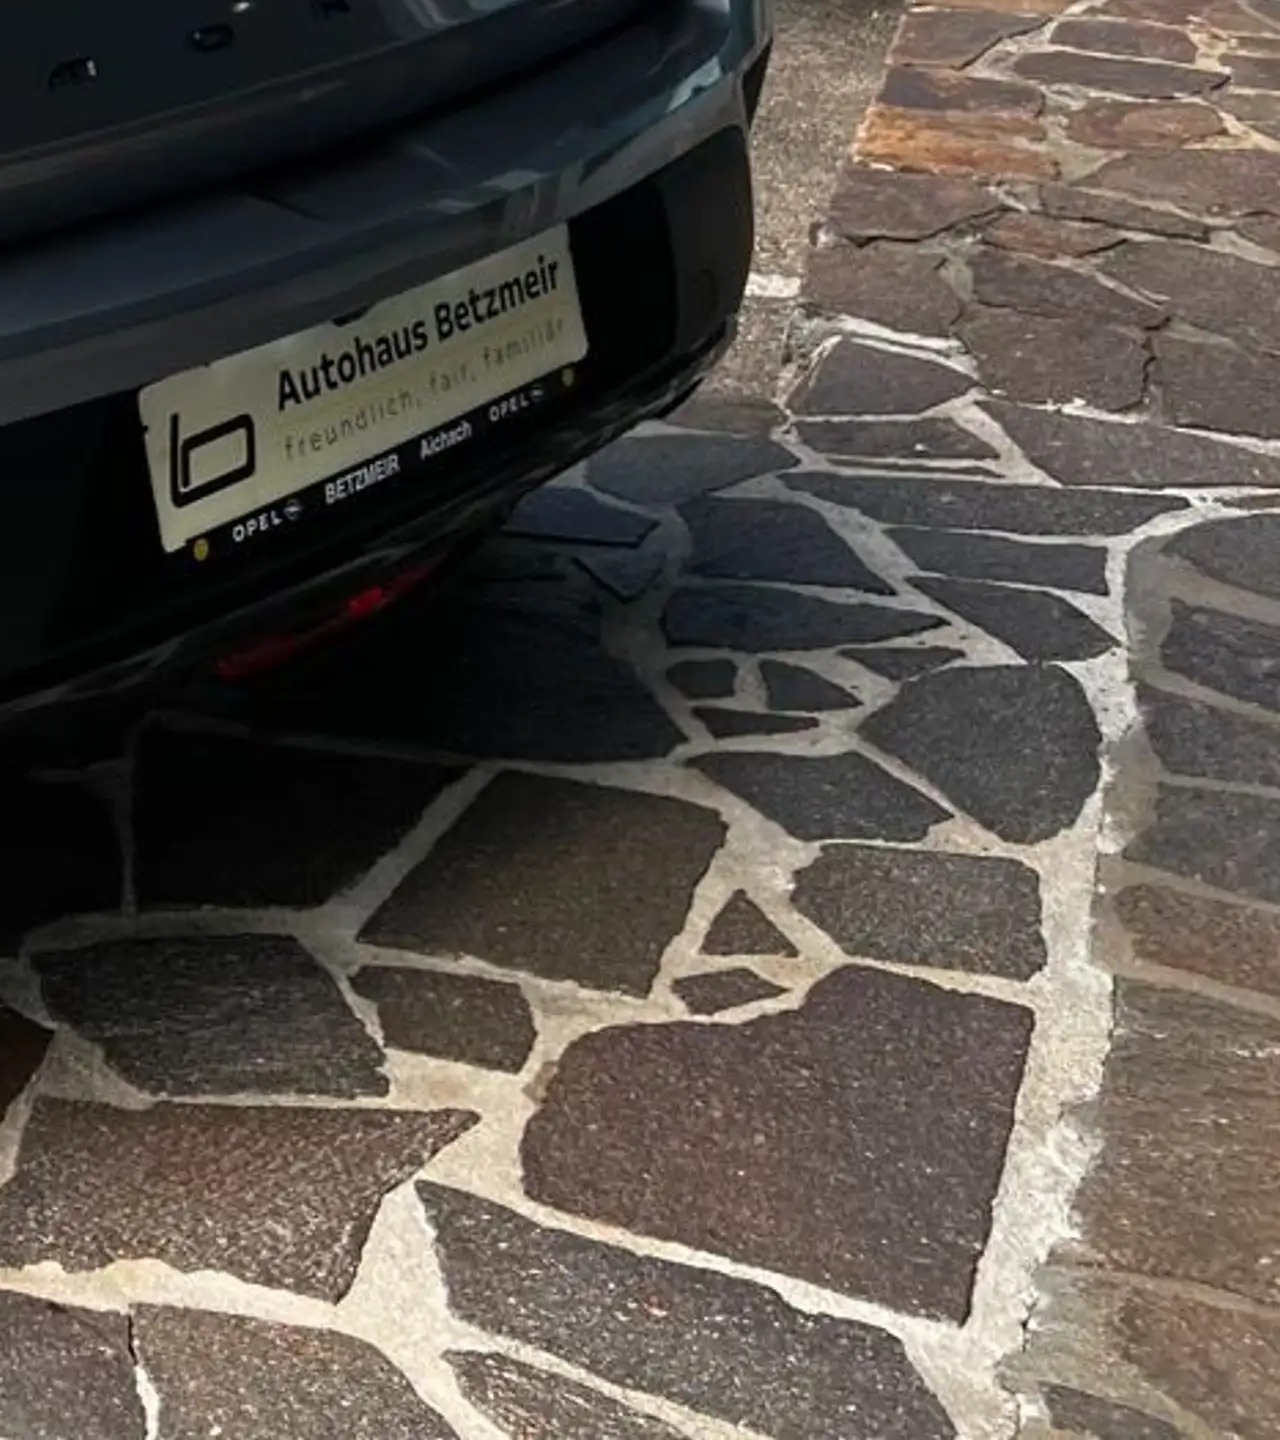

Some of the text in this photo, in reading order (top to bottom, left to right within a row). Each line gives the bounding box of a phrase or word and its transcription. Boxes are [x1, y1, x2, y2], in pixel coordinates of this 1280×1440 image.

[278, 255, 559, 411] Autohaus Betzmeir
[231, 510, 284, 543] OPEL
[324, 454, 401, 505] BETZMEIR
[488, 391, 530, 423] OPEL
